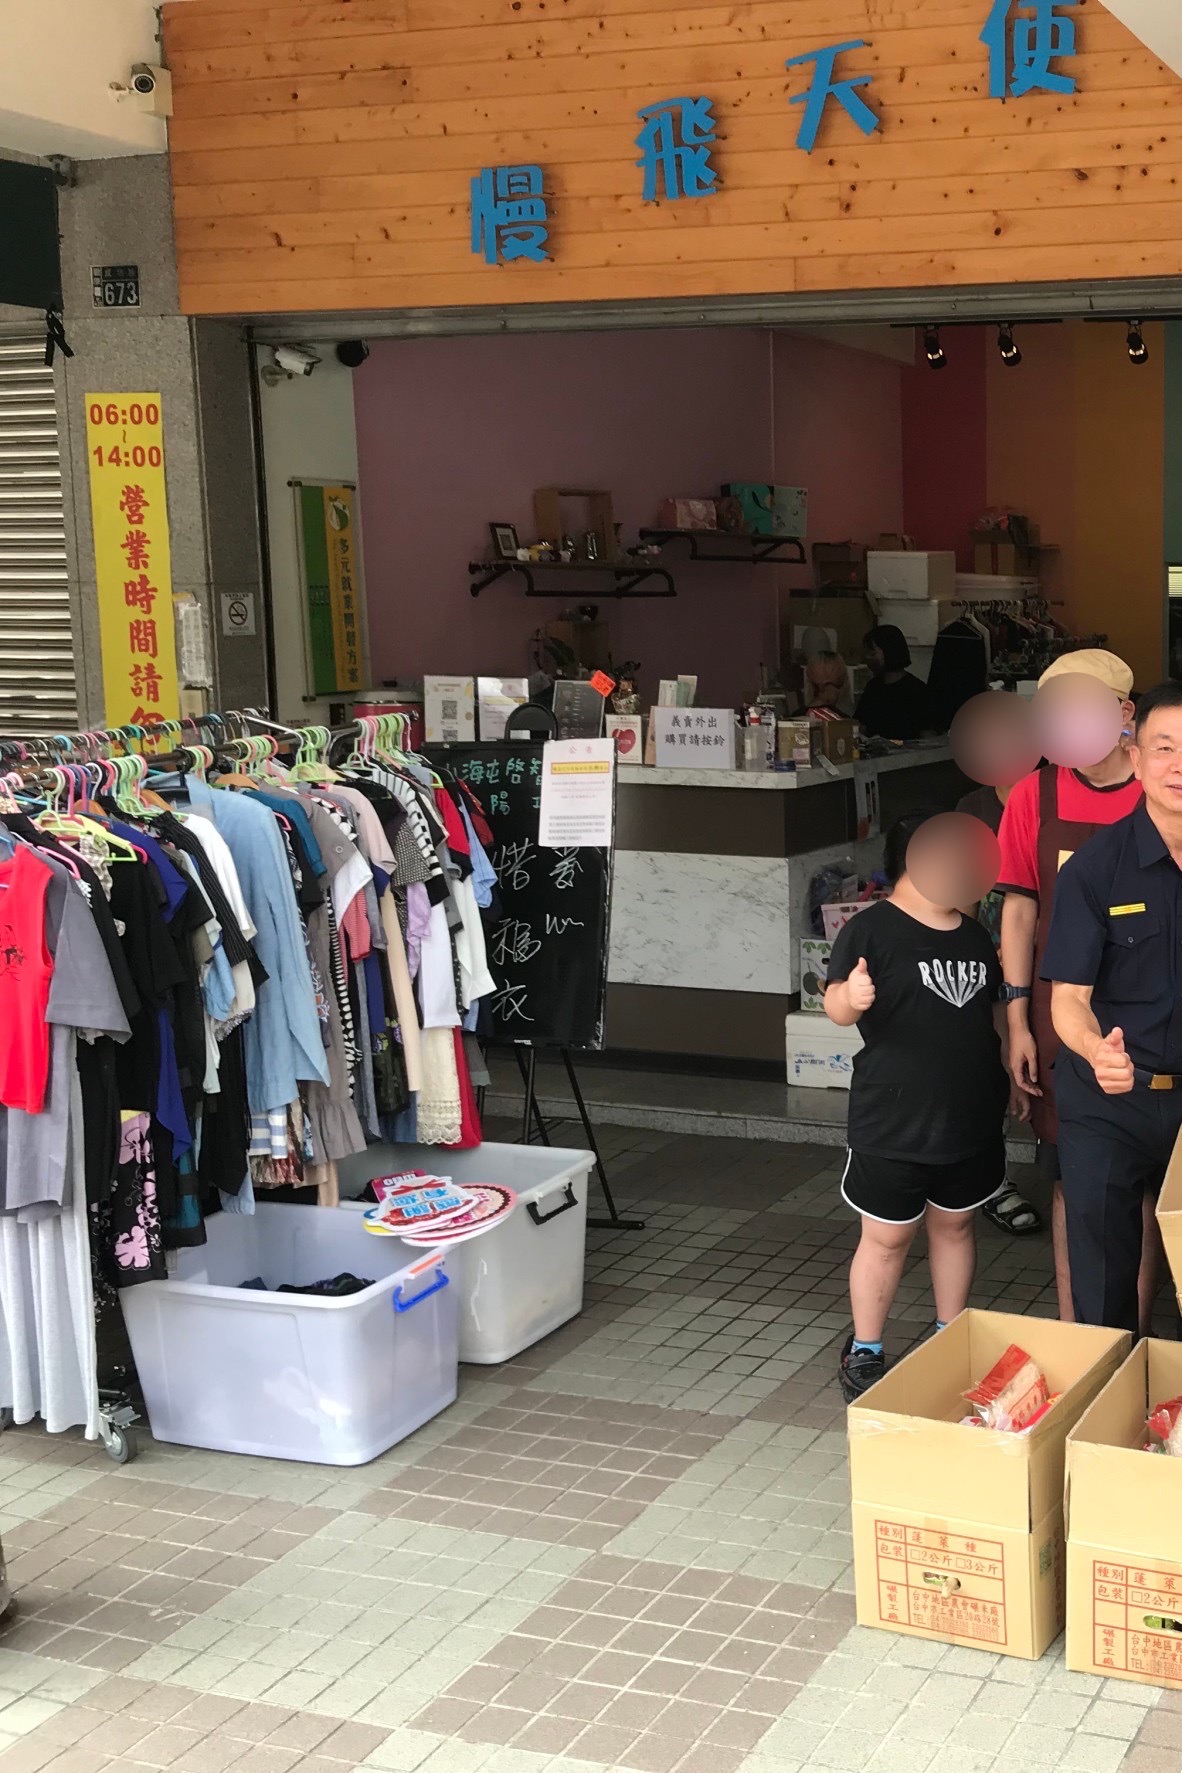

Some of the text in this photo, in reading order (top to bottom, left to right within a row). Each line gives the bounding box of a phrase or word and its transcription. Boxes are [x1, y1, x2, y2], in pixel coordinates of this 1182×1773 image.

[471, 0, 1078, 265] 慢飛天使
[105, 282, 138, 304] 673
[90, 404, 159, 426] 06:00
[93, 445, 162, 468] 14:00
[671, 715, 718, 728] 義賣外出
[665, 733, 725, 747] 購買請按鈴
[918, 958, 987, 986] ROCKER
[879, 1525, 903, 1539] 種別
[880, 1543, 904, 1558] 包裝
[1097, 1566, 1124, 1581] 種別
[1098, 1584, 1124, 1600] 包裝
